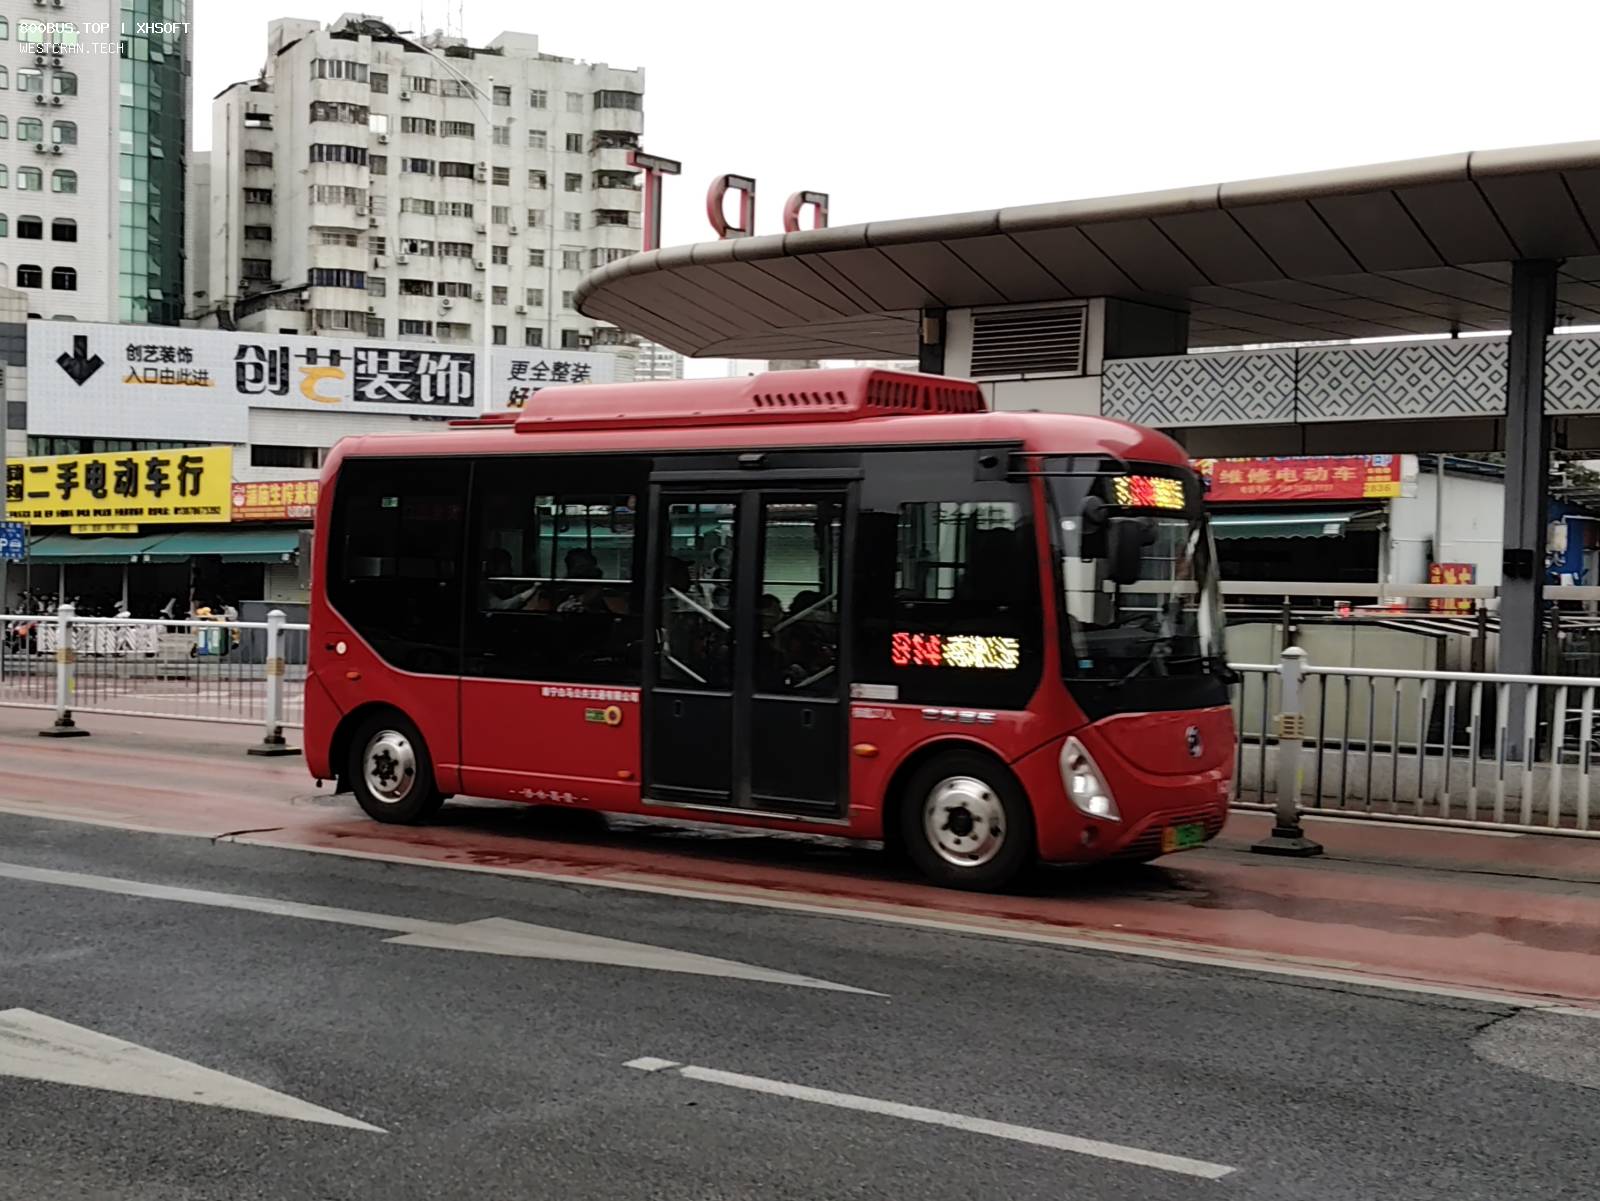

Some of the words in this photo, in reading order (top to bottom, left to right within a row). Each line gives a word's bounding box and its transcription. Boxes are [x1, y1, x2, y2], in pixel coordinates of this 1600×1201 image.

[125, 343, 194, 364] 创艺装饰
[125, 367, 209, 387] 入口由此进
[234, 344, 474, 406] 创艺装饰
[507, 360, 592, 384] 更全整装
[506, 386, 542, 408] 好
[28, 455, 204, 501] 二手电动车行
[1219, 466, 1357, 485] 维修电动车
